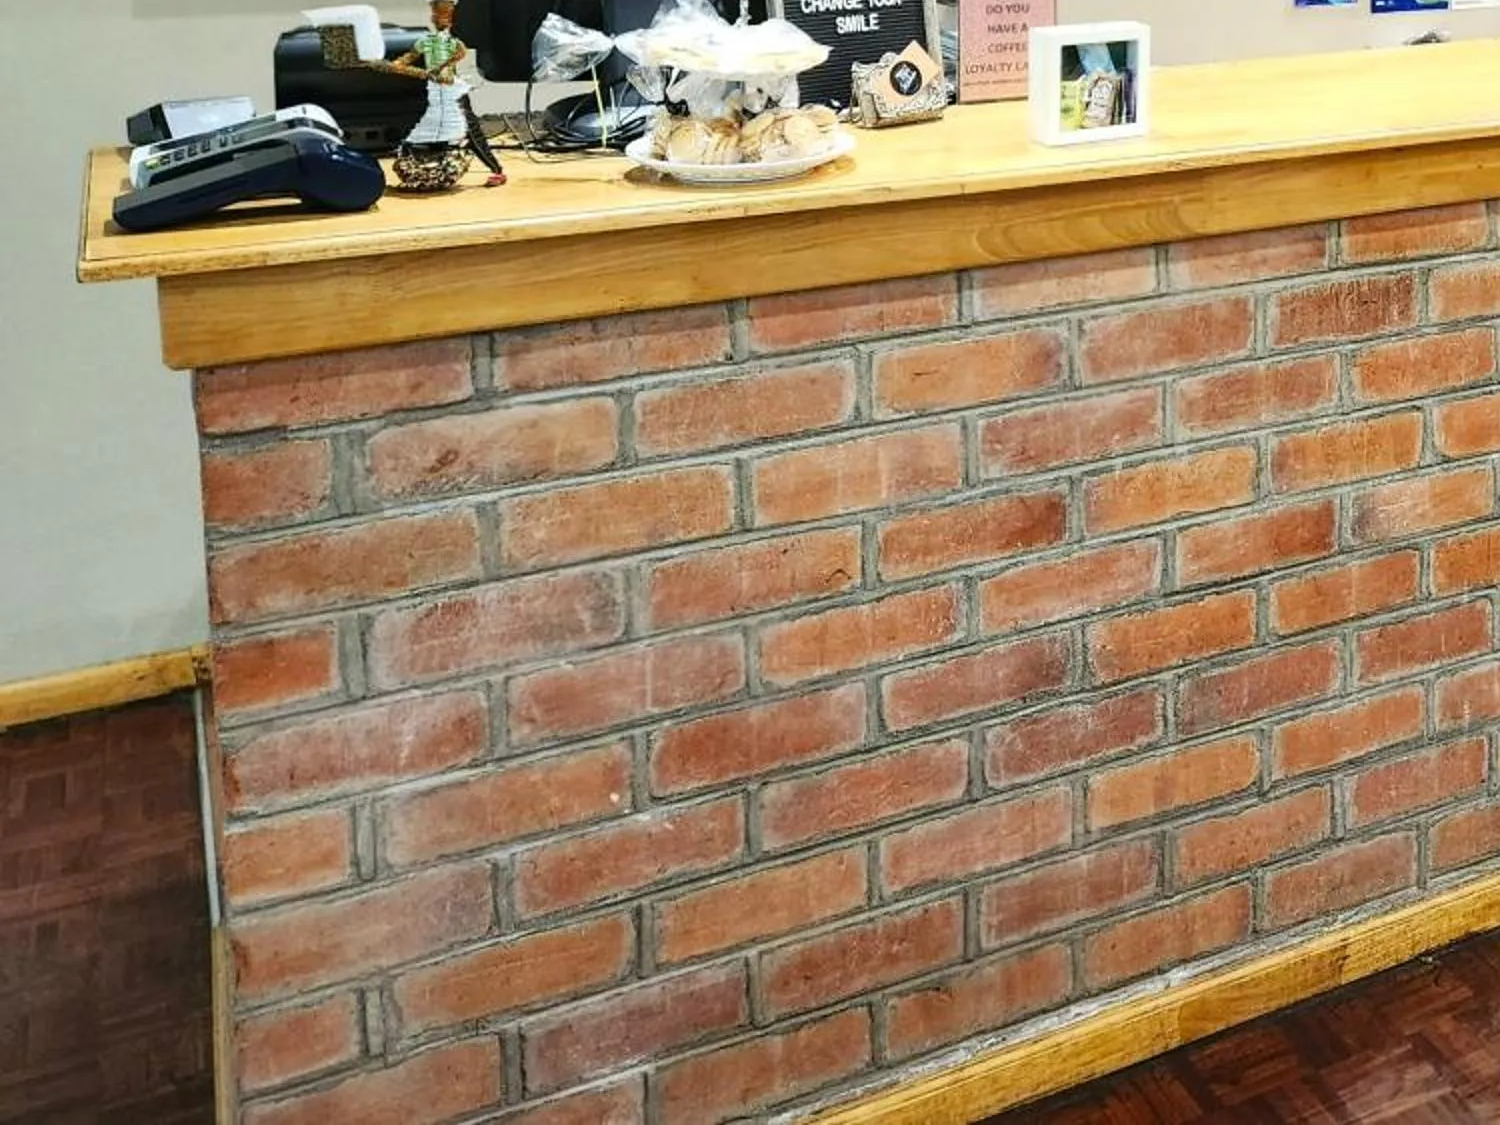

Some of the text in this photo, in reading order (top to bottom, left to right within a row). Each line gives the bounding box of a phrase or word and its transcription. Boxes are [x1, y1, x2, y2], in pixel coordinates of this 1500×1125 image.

[985, 2, 1030, 15] DO YOU
[835, 13, 880, 34] SMILE
[987, 21, 1029, 34] HAVE A
[965, 61, 1013, 75] LOYALTY
